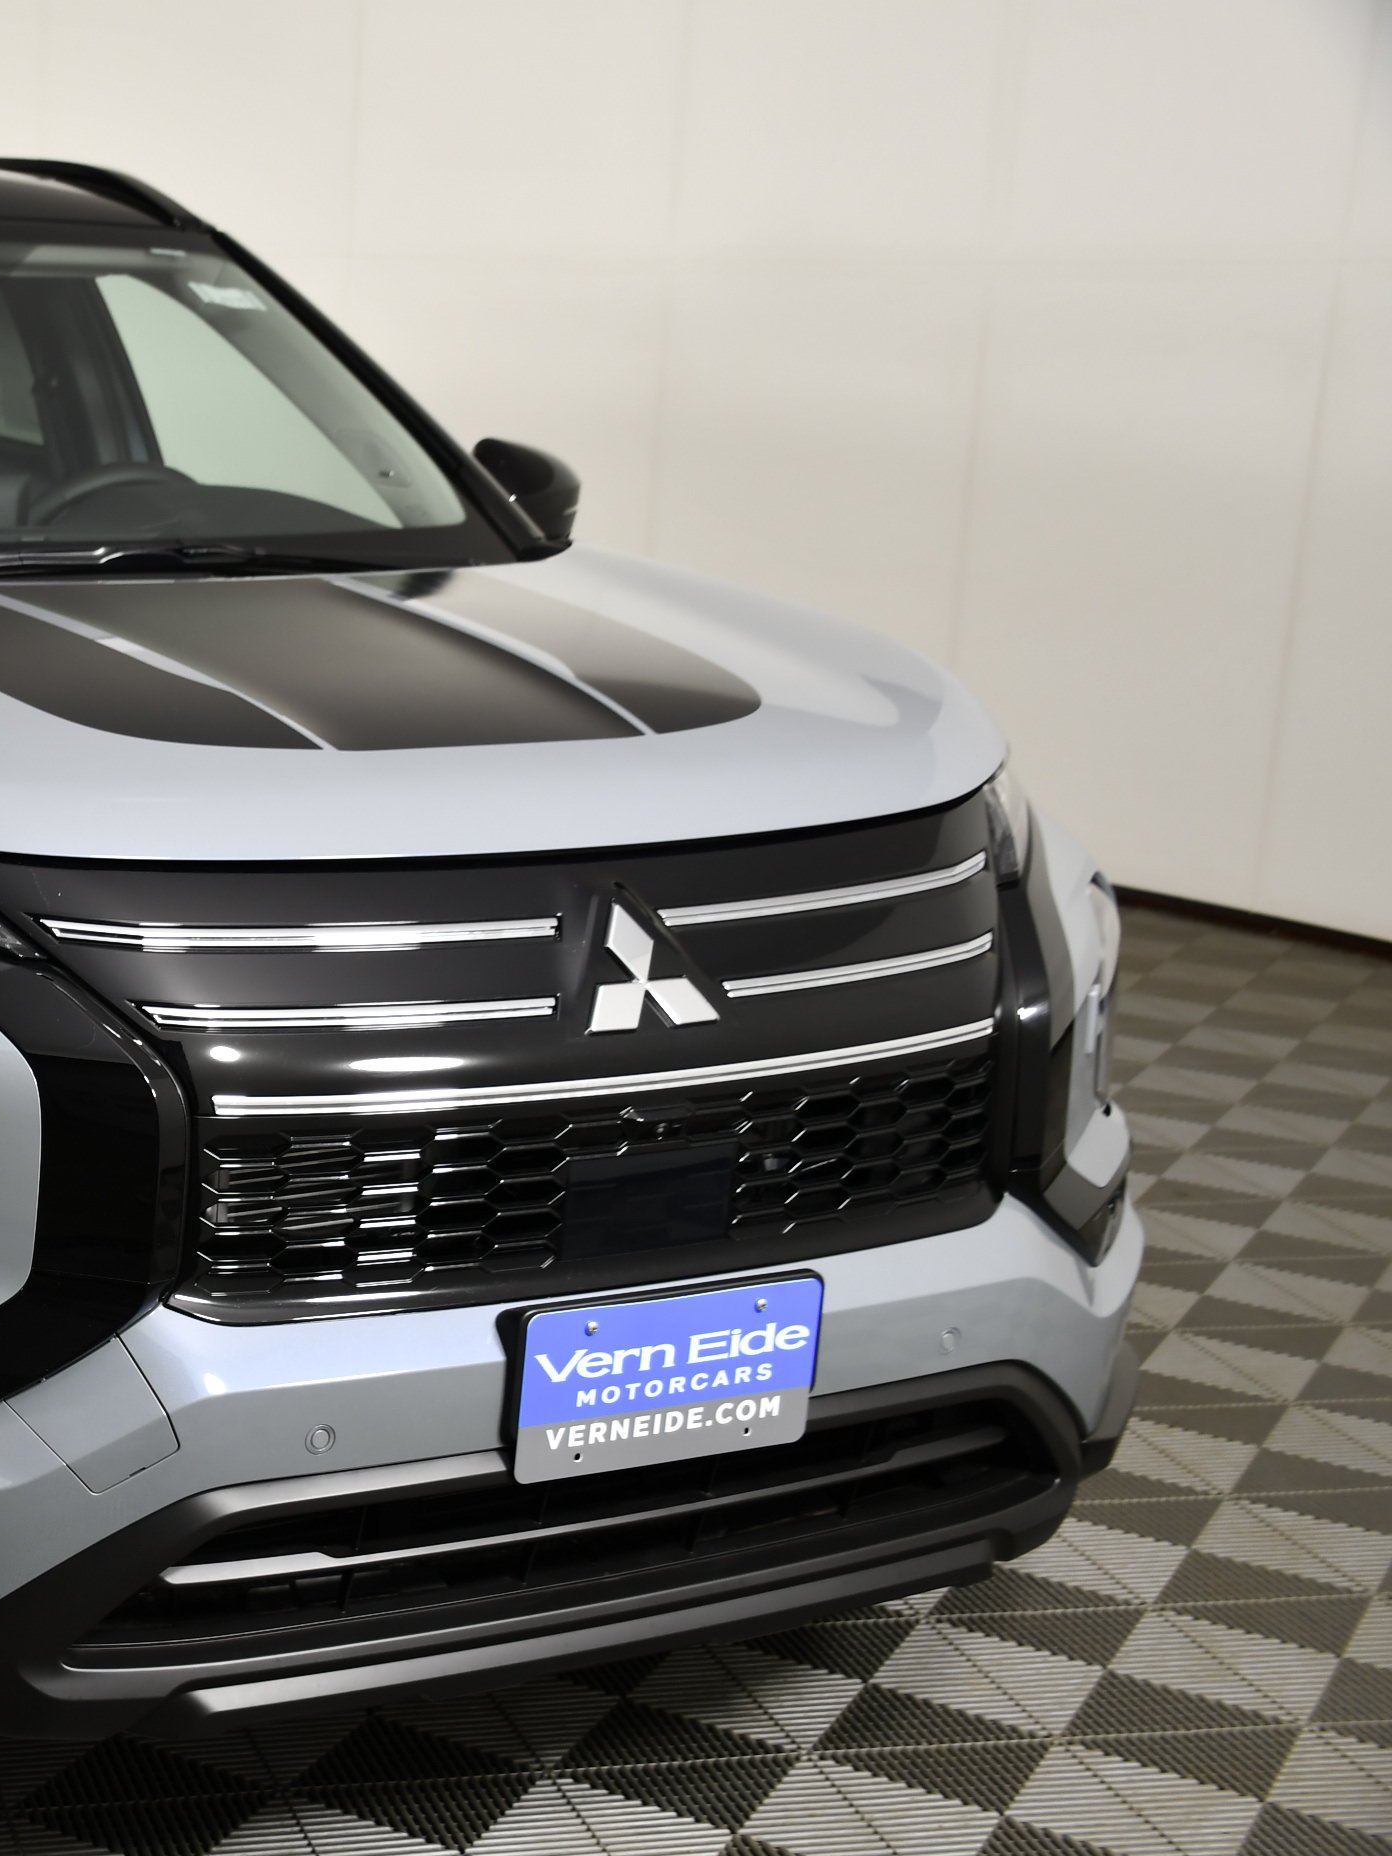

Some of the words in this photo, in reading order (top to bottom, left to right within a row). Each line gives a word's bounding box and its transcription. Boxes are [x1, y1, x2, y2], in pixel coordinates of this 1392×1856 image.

[533, 1343, 676, 1383] Vern
[686, 1322, 811, 1365] Eide
[575, 1362, 773, 1408] MOTORCARS
[545, 1395, 781, 1450] VERNEIDE.COM
